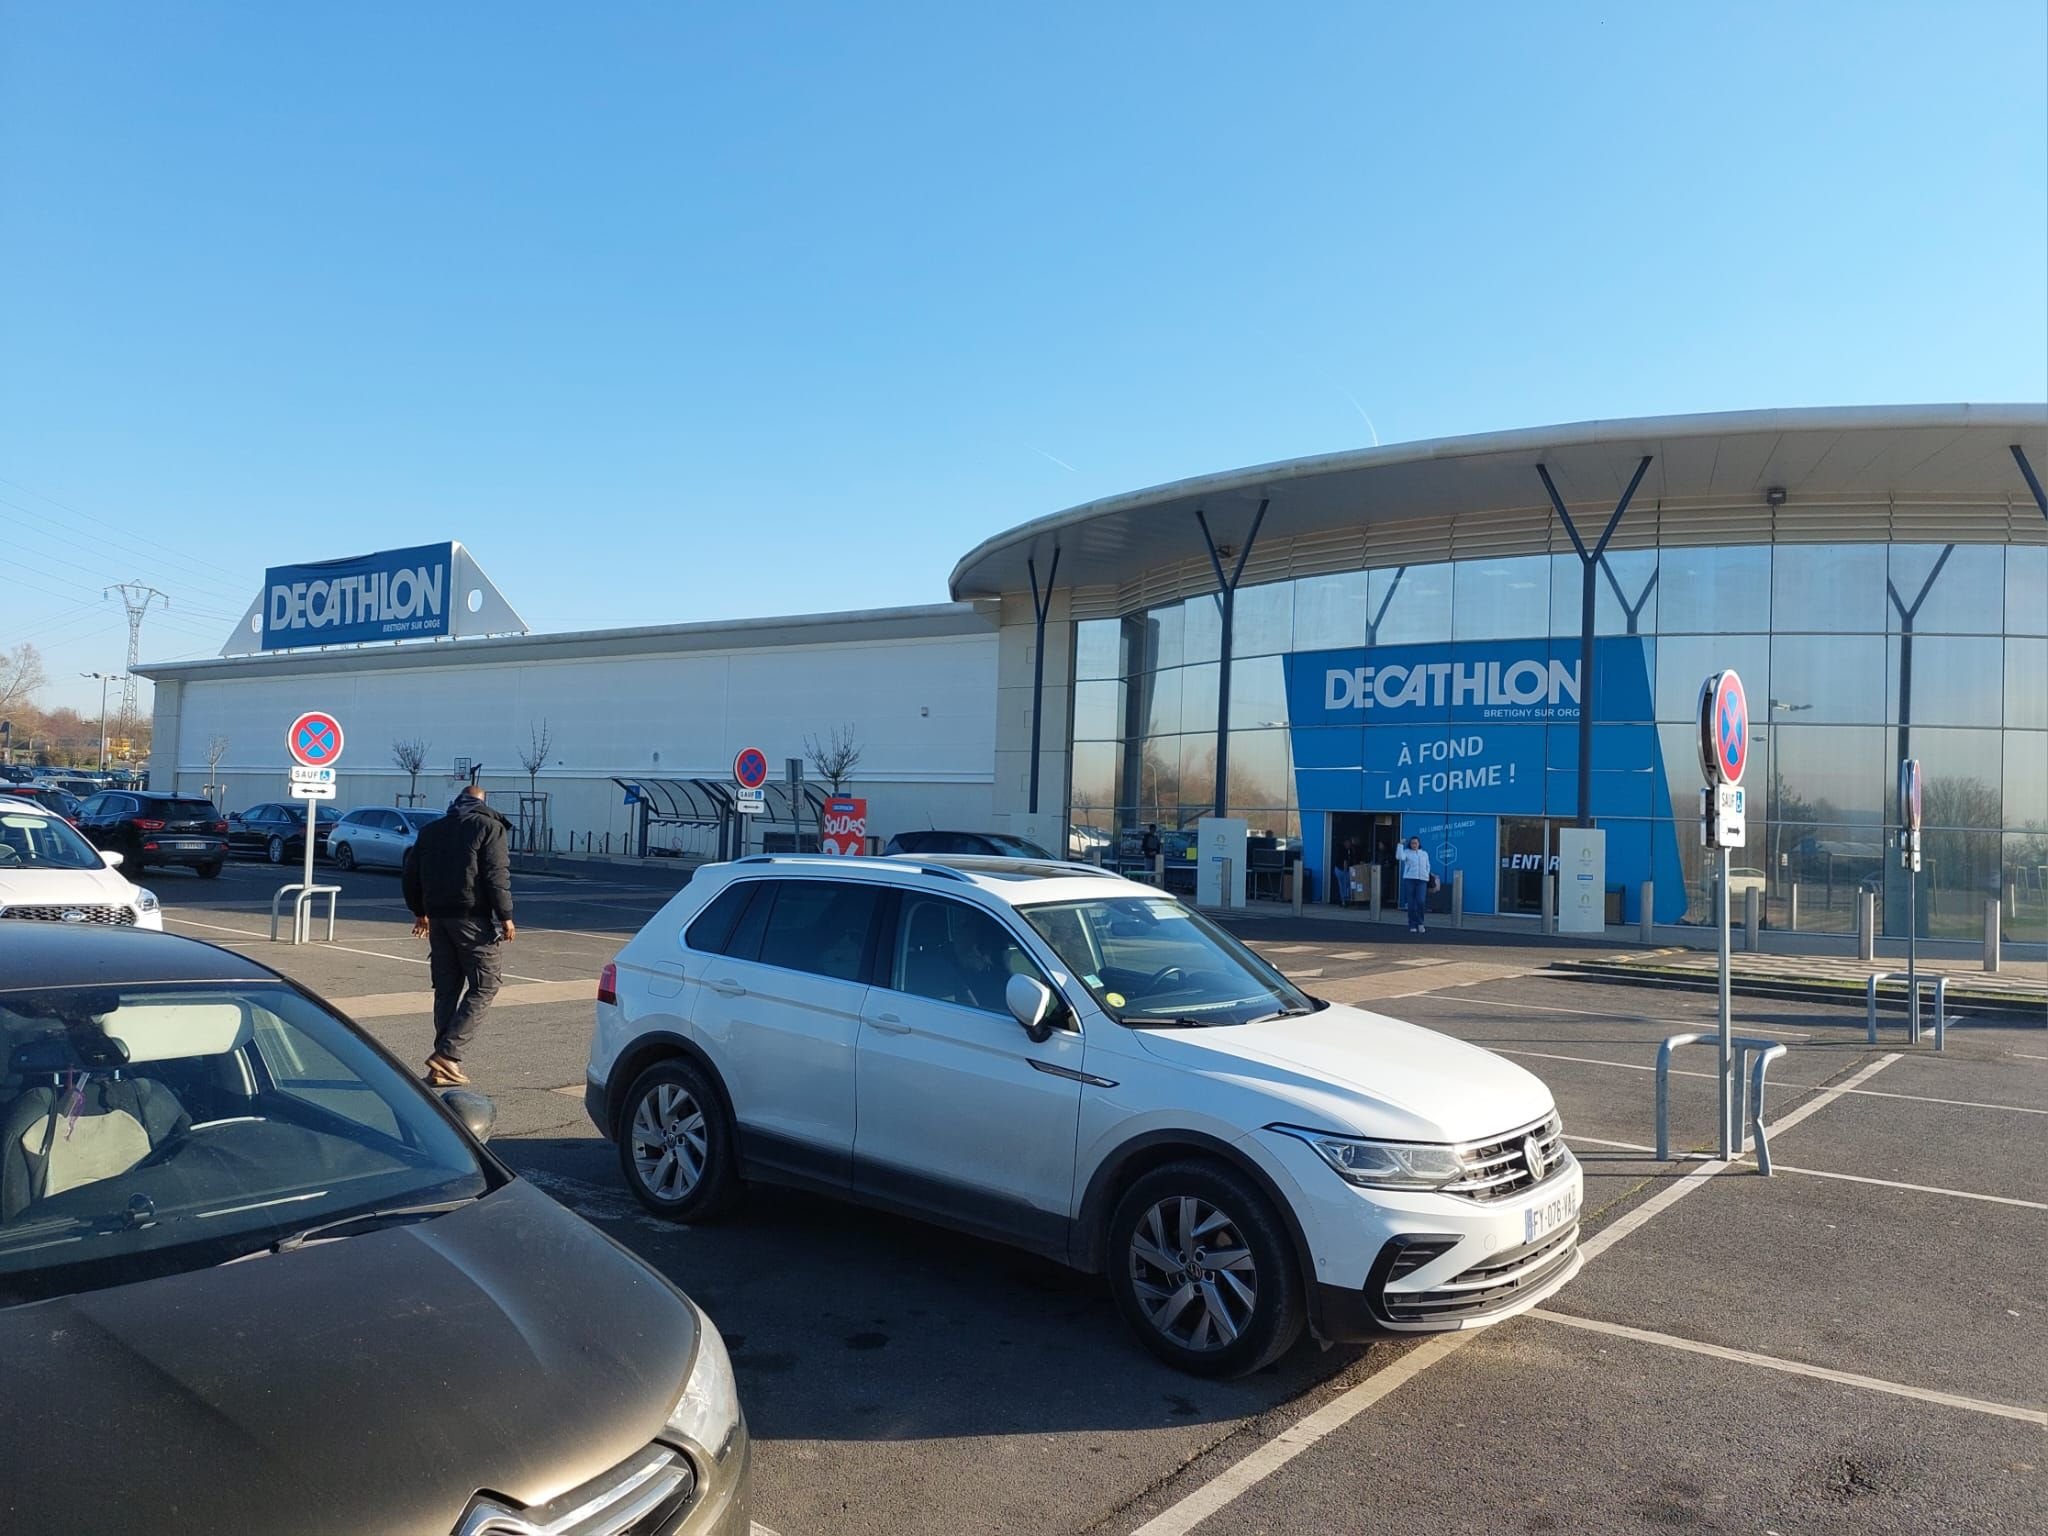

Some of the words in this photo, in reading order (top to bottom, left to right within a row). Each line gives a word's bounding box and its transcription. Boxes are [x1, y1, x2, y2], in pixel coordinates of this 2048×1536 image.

[270, 564, 443, 631] DECATHLON
[411, 621, 423, 631] SUR
[423, 618, 441, 629] ORGE
[1325, 659, 1582, 710] DECATHLON
[1483, 708, 1532, 718] BRETIGNY
[1534, 708, 1555, 718] SUR
[1557, 708, 1581, 717] ORG
[1397, 741, 1413, 767] À
[1419, 735, 1484, 764] FOND
[294, 770, 319, 779] SAUF
[1385, 778, 1412, 799] LA
[1419, 765, 1502, 795] FORME
[1511, 854, 1560, 870] ENTR
